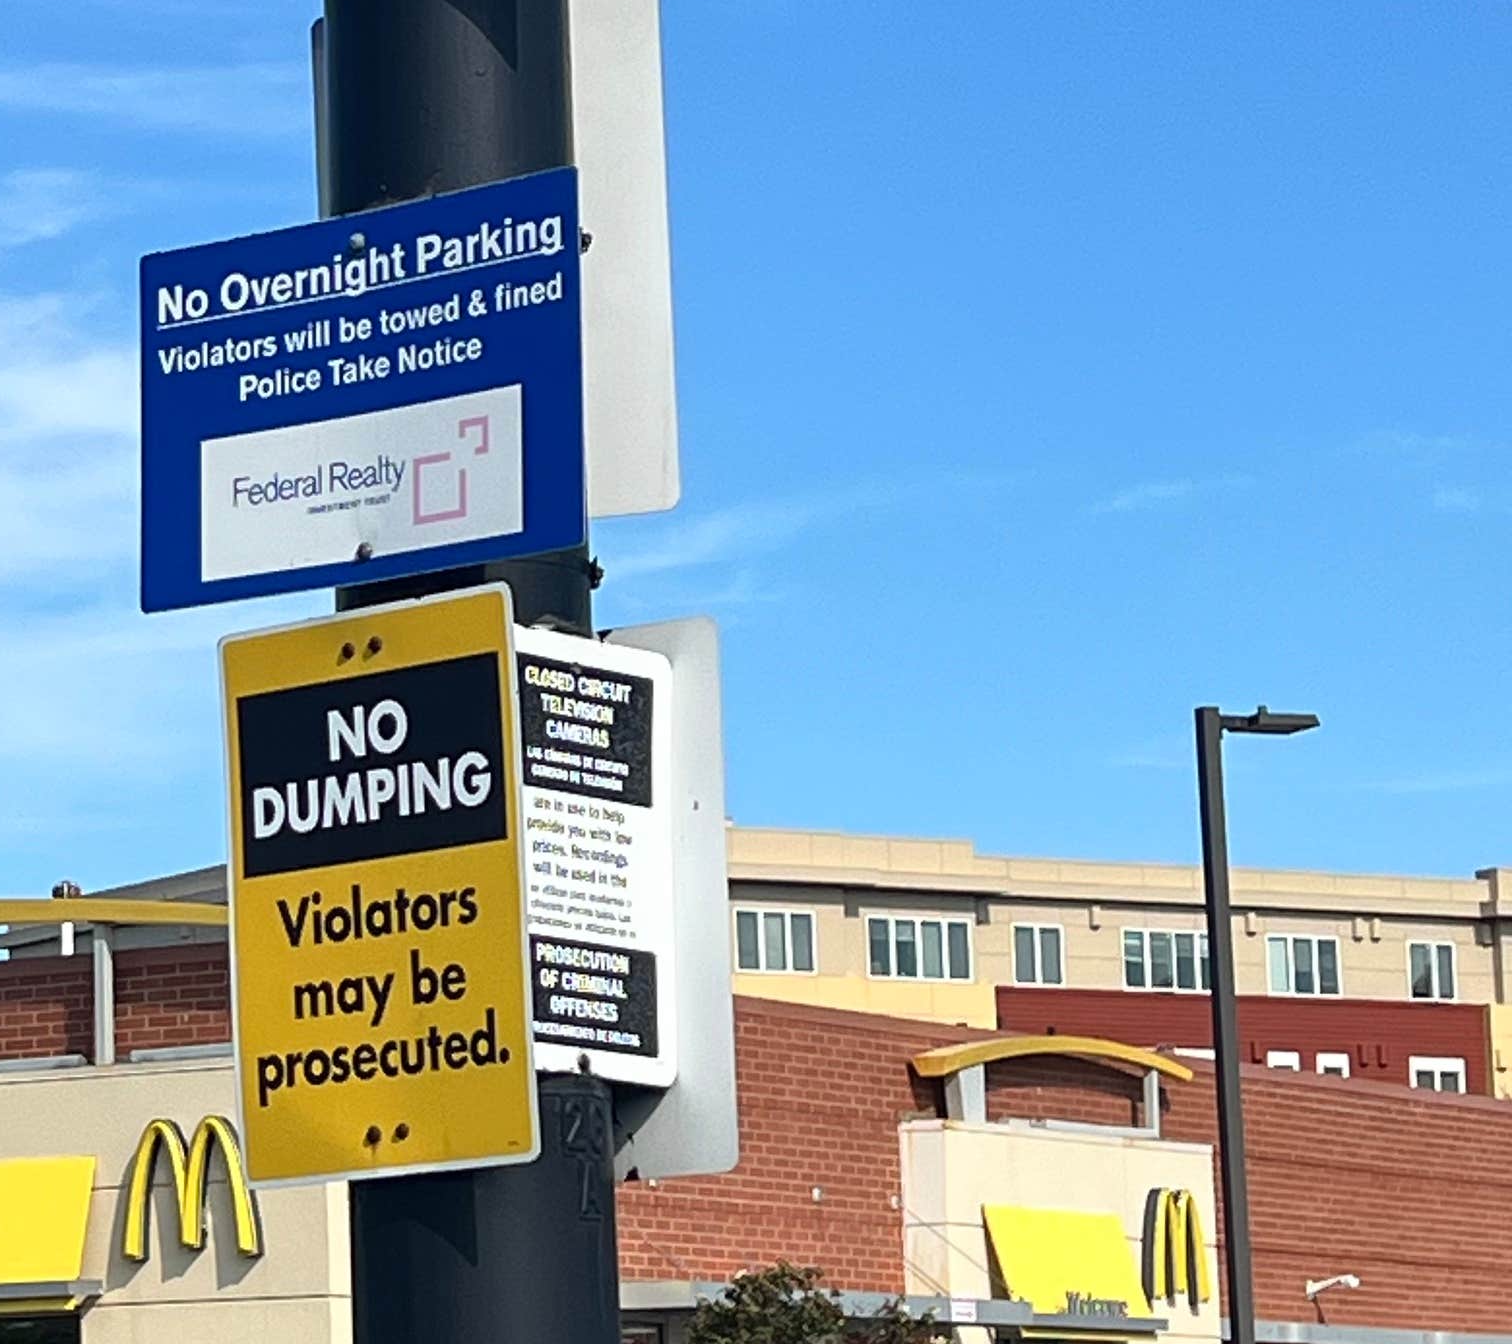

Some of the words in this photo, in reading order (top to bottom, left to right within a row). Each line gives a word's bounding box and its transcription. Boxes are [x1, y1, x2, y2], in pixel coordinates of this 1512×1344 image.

[158, 284, 208, 325] No
[220, 243, 406, 312] Overnight
[416, 216, 563, 274] Parking
[158, 336, 277, 375] Violators
[284, 319, 330, 353] will
[339, 317, 372, 343] be
[380, 294, 460, 335] towed
[467, 289, 488, 317] &
[494, 272, 562, 312] fined
[240, 368, 321, 402] Police
[327, 354, 390, 386] Take
[398, 337, 482, 374] Notice
[232, 464, 323, 507] Federal
[329, 454, 406, 492] Realty
[525, 665, 575, 692] CLOSED
[578, 676, 632, 704] CIRCUIT
[540, 693, 614, 725] TELEVISION
[327, 699, 408, 762] NO
[546, 719, 610, 748] CAMERAS
[253, 751, 491, 839] DUMPING
[276, 884, 478, 948] Violators
[294, 973, 395, 1028] may
[410, 949, 467, 1005] be
[536, 943, 630, 975] PROSECUTION
[540, 968, 559, 989] OF
[561, 972, 628, 999] CRIMINAL
[550, 995, 619, 1023] OFFENSES
[257, 1007, 511, 1108] prosecuted.
